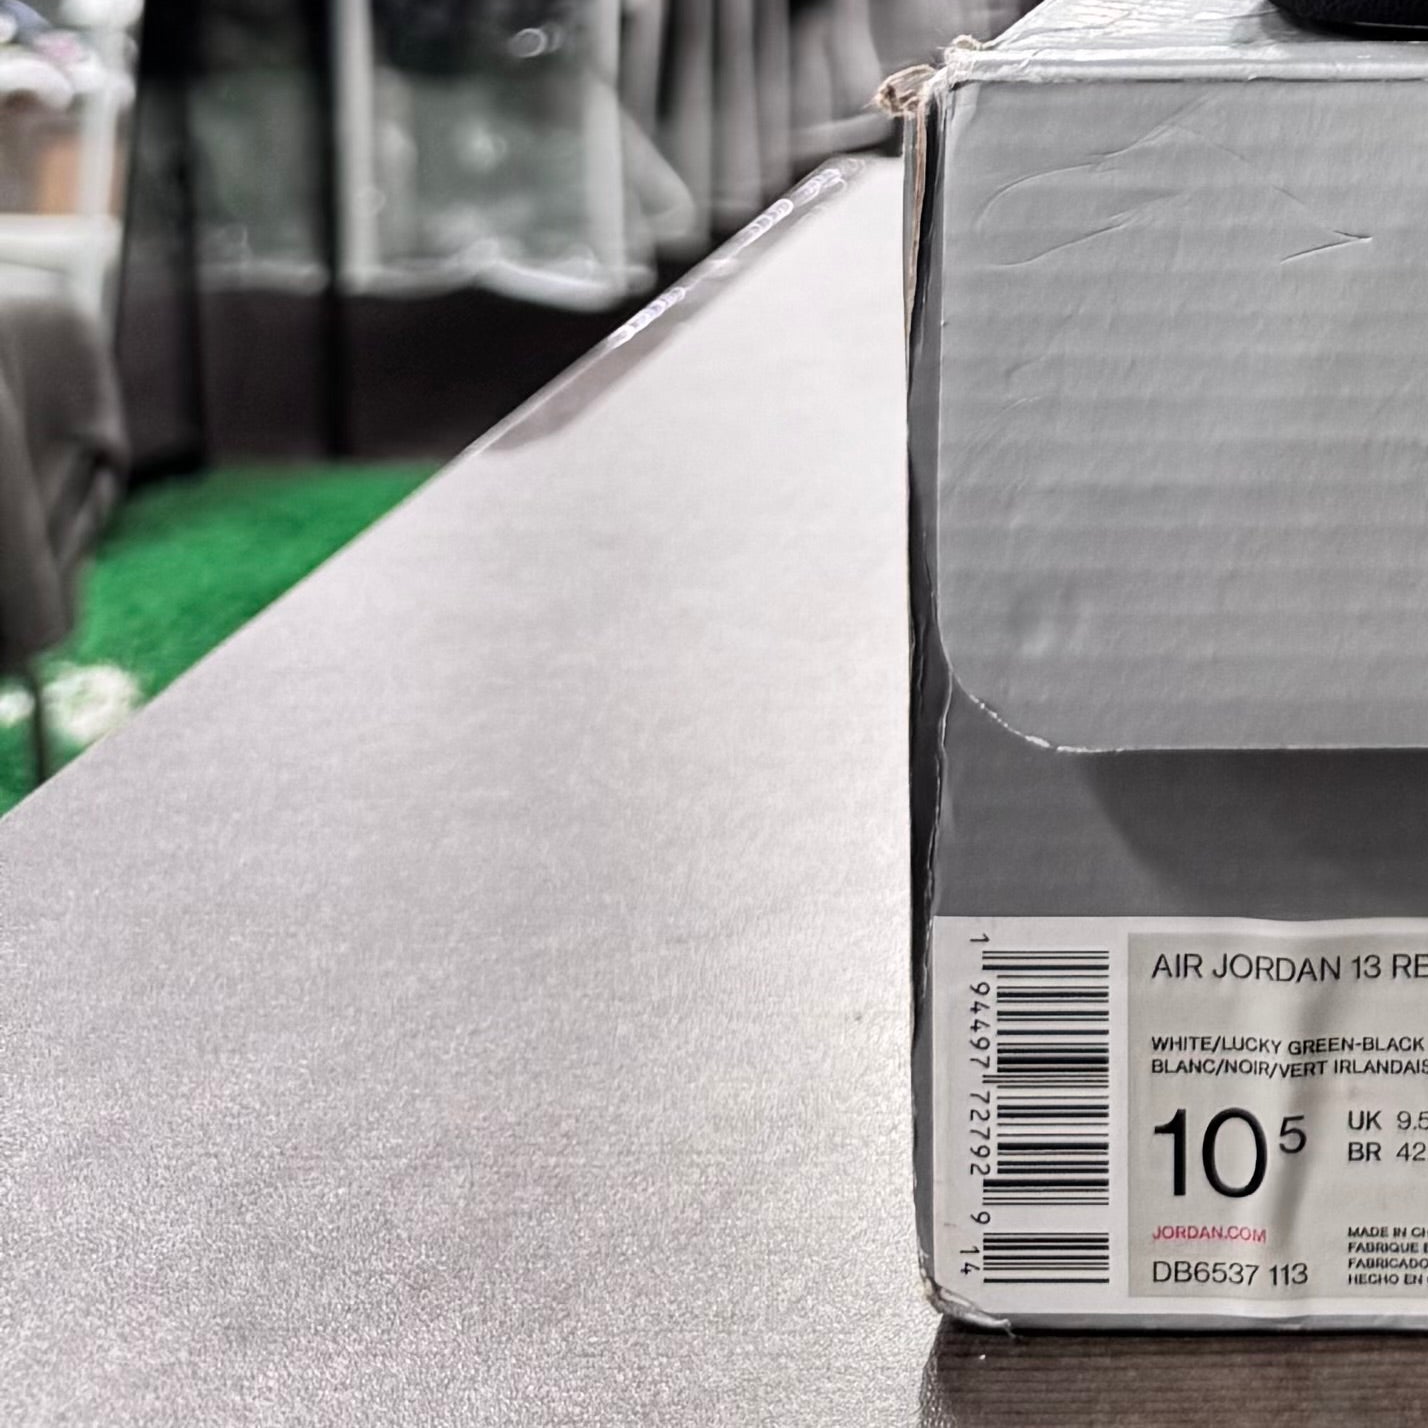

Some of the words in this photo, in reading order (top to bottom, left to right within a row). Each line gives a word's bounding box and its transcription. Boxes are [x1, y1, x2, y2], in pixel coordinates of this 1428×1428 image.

[1151, 953, 1203, 979] AIR
[1212, 952, 1341, 982] JORDAN
[1351, 954, 1382, 980] 13
[970, 982, 990, 1069] 94497
[1151, 1036, 1282, 1054] WHITE/LUCKY
[1287, 1036, 1425, 1055] GREEN-BLACK
[1151, 1058, 1328, 1079] BLANC/NOIR/VERT
[1348, 1110, 1382, 1131] UK
[970, 1091, 990, 1176] 72792
[1348, 1142, 1382, 1162] BR
[970, 1211, 990, 1225] 9
[1152, 1225, 1267, 1242] JORDAN.COM
[1348, 1226, 1389, 1238] MADE
[1393, 1226, 1408, 1238] IN
[1152, 1260, 1259, 1286] DB6537
[1268, 1262, 1309, 1286] 113
[1348, 1273, 1399, 1285] HECHO
[1404, 1273, 1424, 1285] EN
